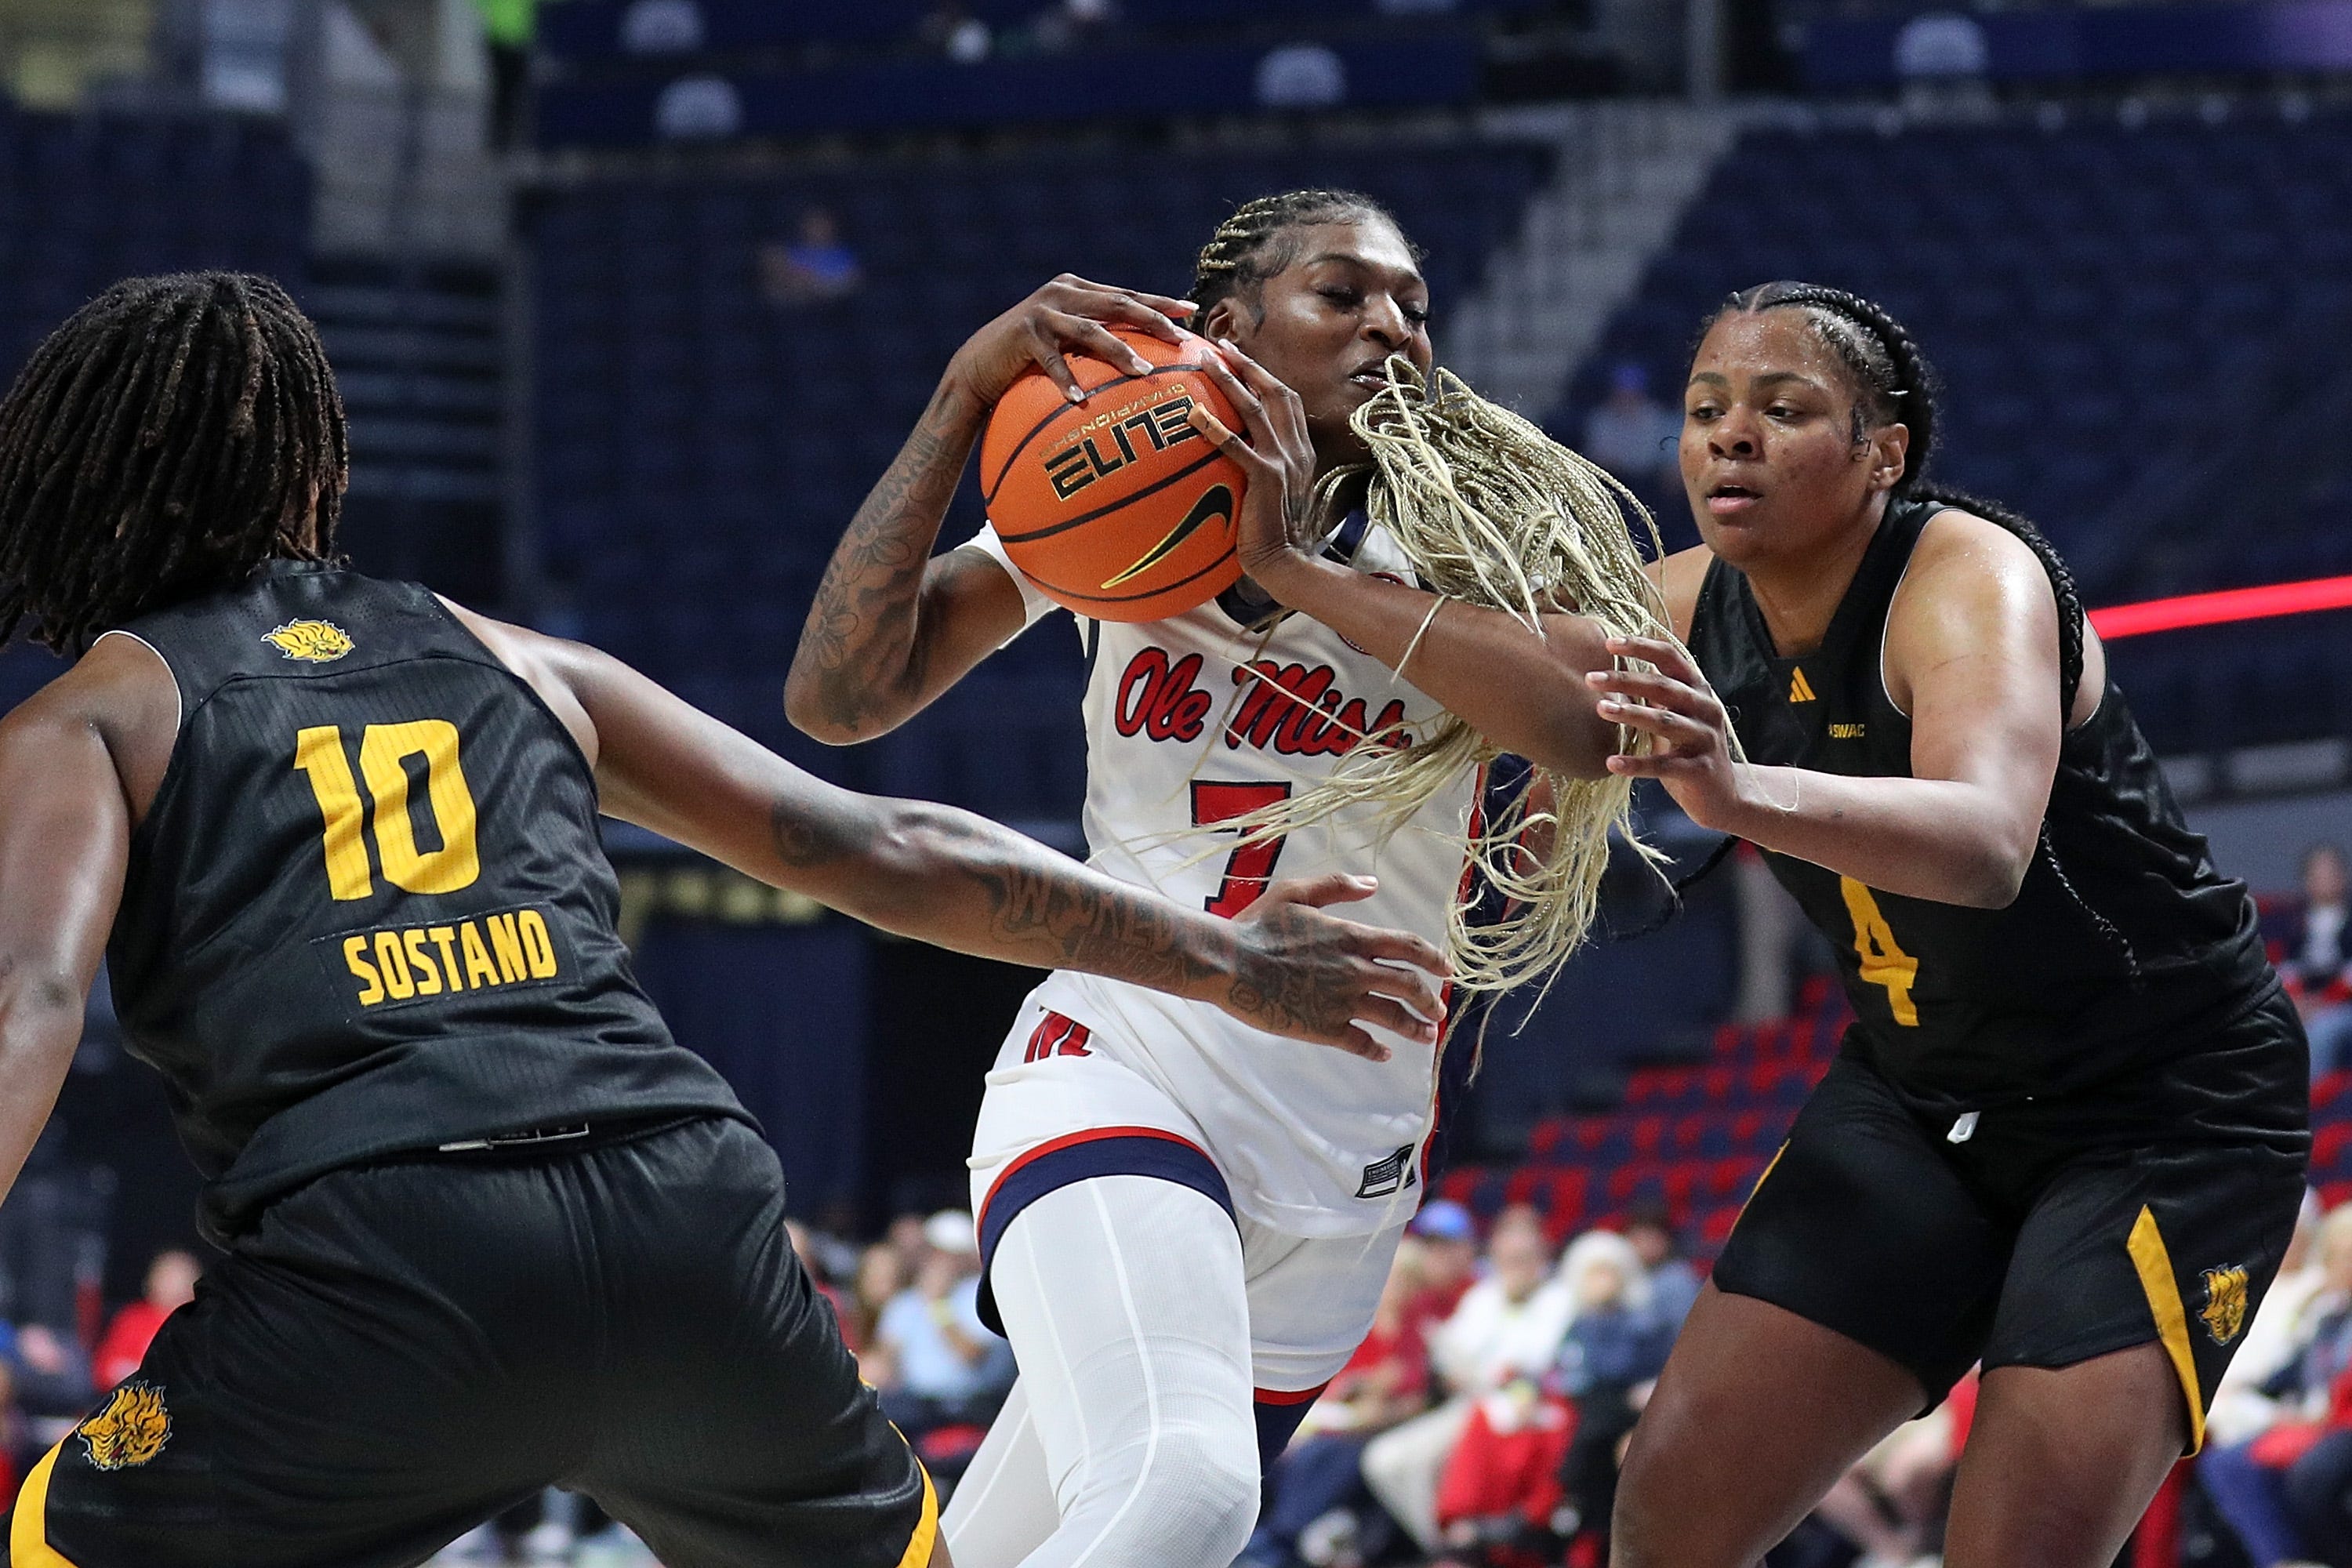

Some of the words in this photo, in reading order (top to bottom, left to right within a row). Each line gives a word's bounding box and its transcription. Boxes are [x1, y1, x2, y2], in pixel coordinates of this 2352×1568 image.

[1044, 394, 1203, 502] ELITE
[1115, 646, 1212, 743] Ole
[1225, 659, 1414, 759] Miss
[1833, 723, 1866, 739] SWAC
[294, 718, 481, 902] 10
[1190, 779, 1292, 920] 7
[343, 909, 558, 1007] SOSTAND
[1840, 874, 1920, 1027] 4
